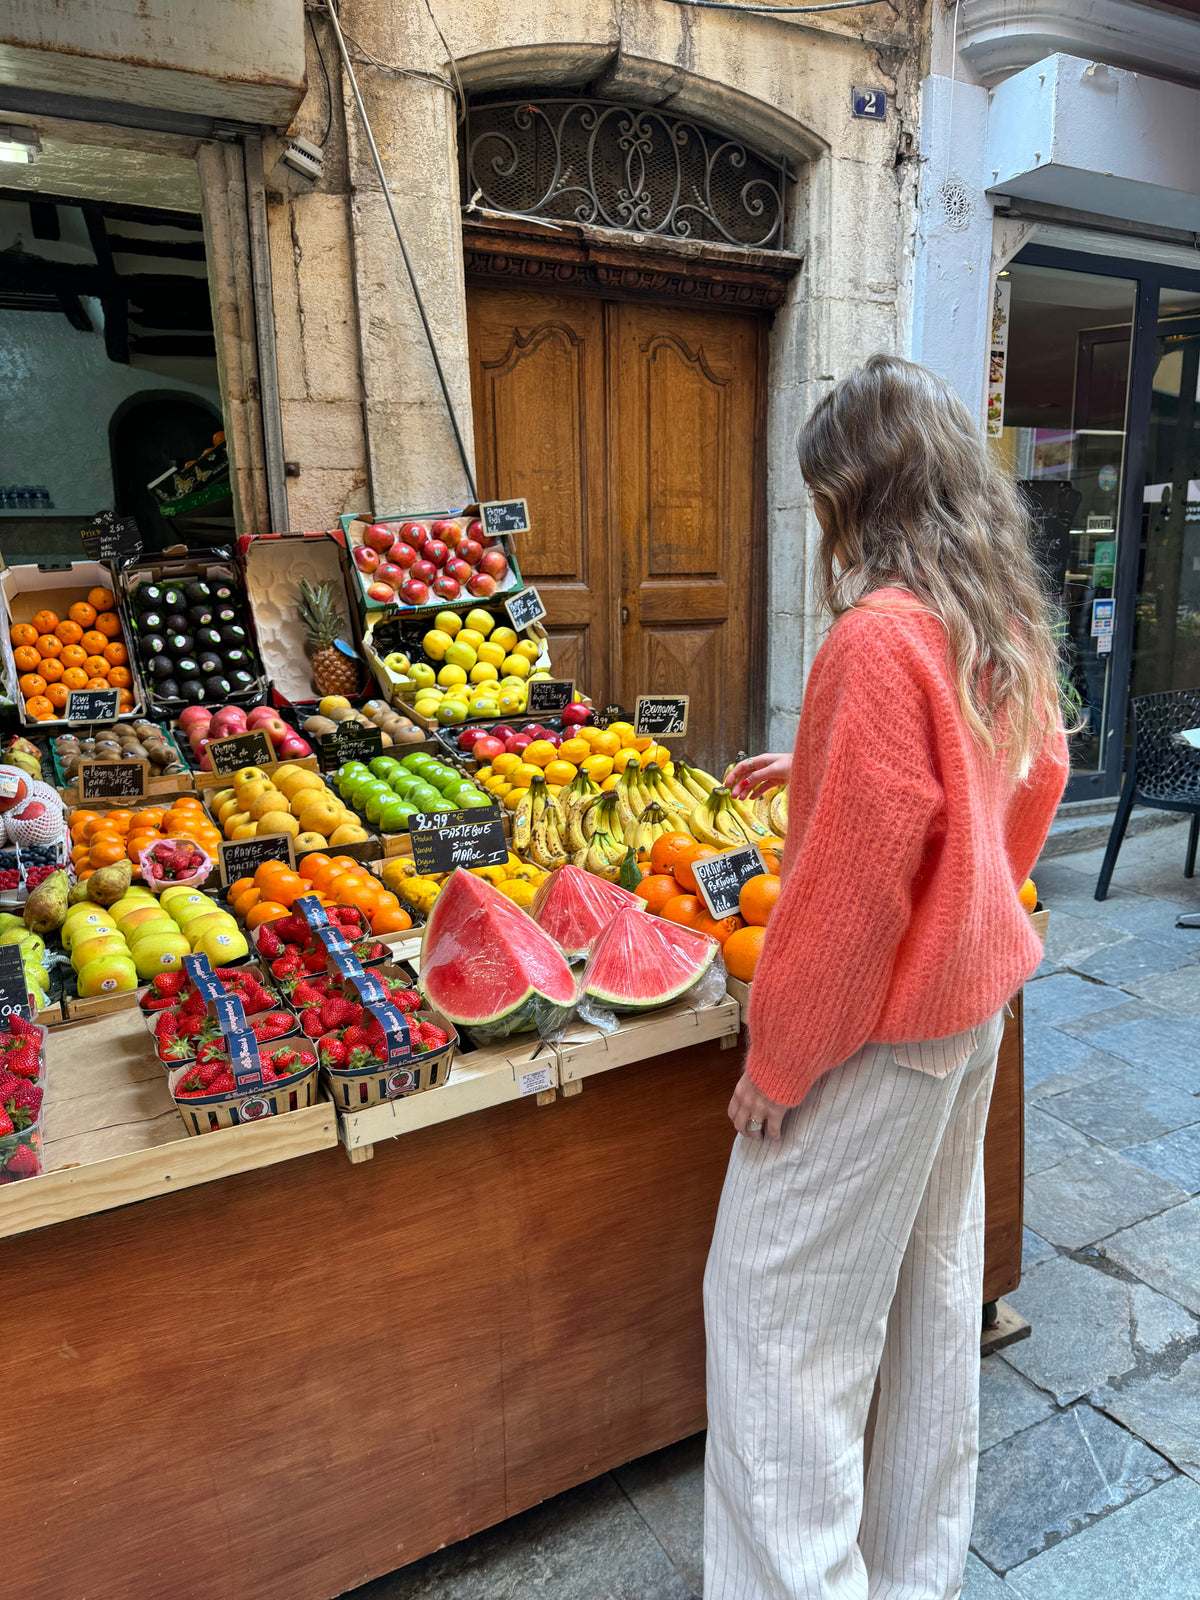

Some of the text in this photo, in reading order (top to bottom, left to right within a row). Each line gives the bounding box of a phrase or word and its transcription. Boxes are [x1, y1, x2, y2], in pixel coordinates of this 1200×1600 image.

[864, 91, 877, 113] 2
[606, 706, 619, 714] 1kg
[439, 823, 492, 840] PASTEQUE
[226, 844, 263, 860] ORANGE
[452, 848, 485, 862] MAROC
